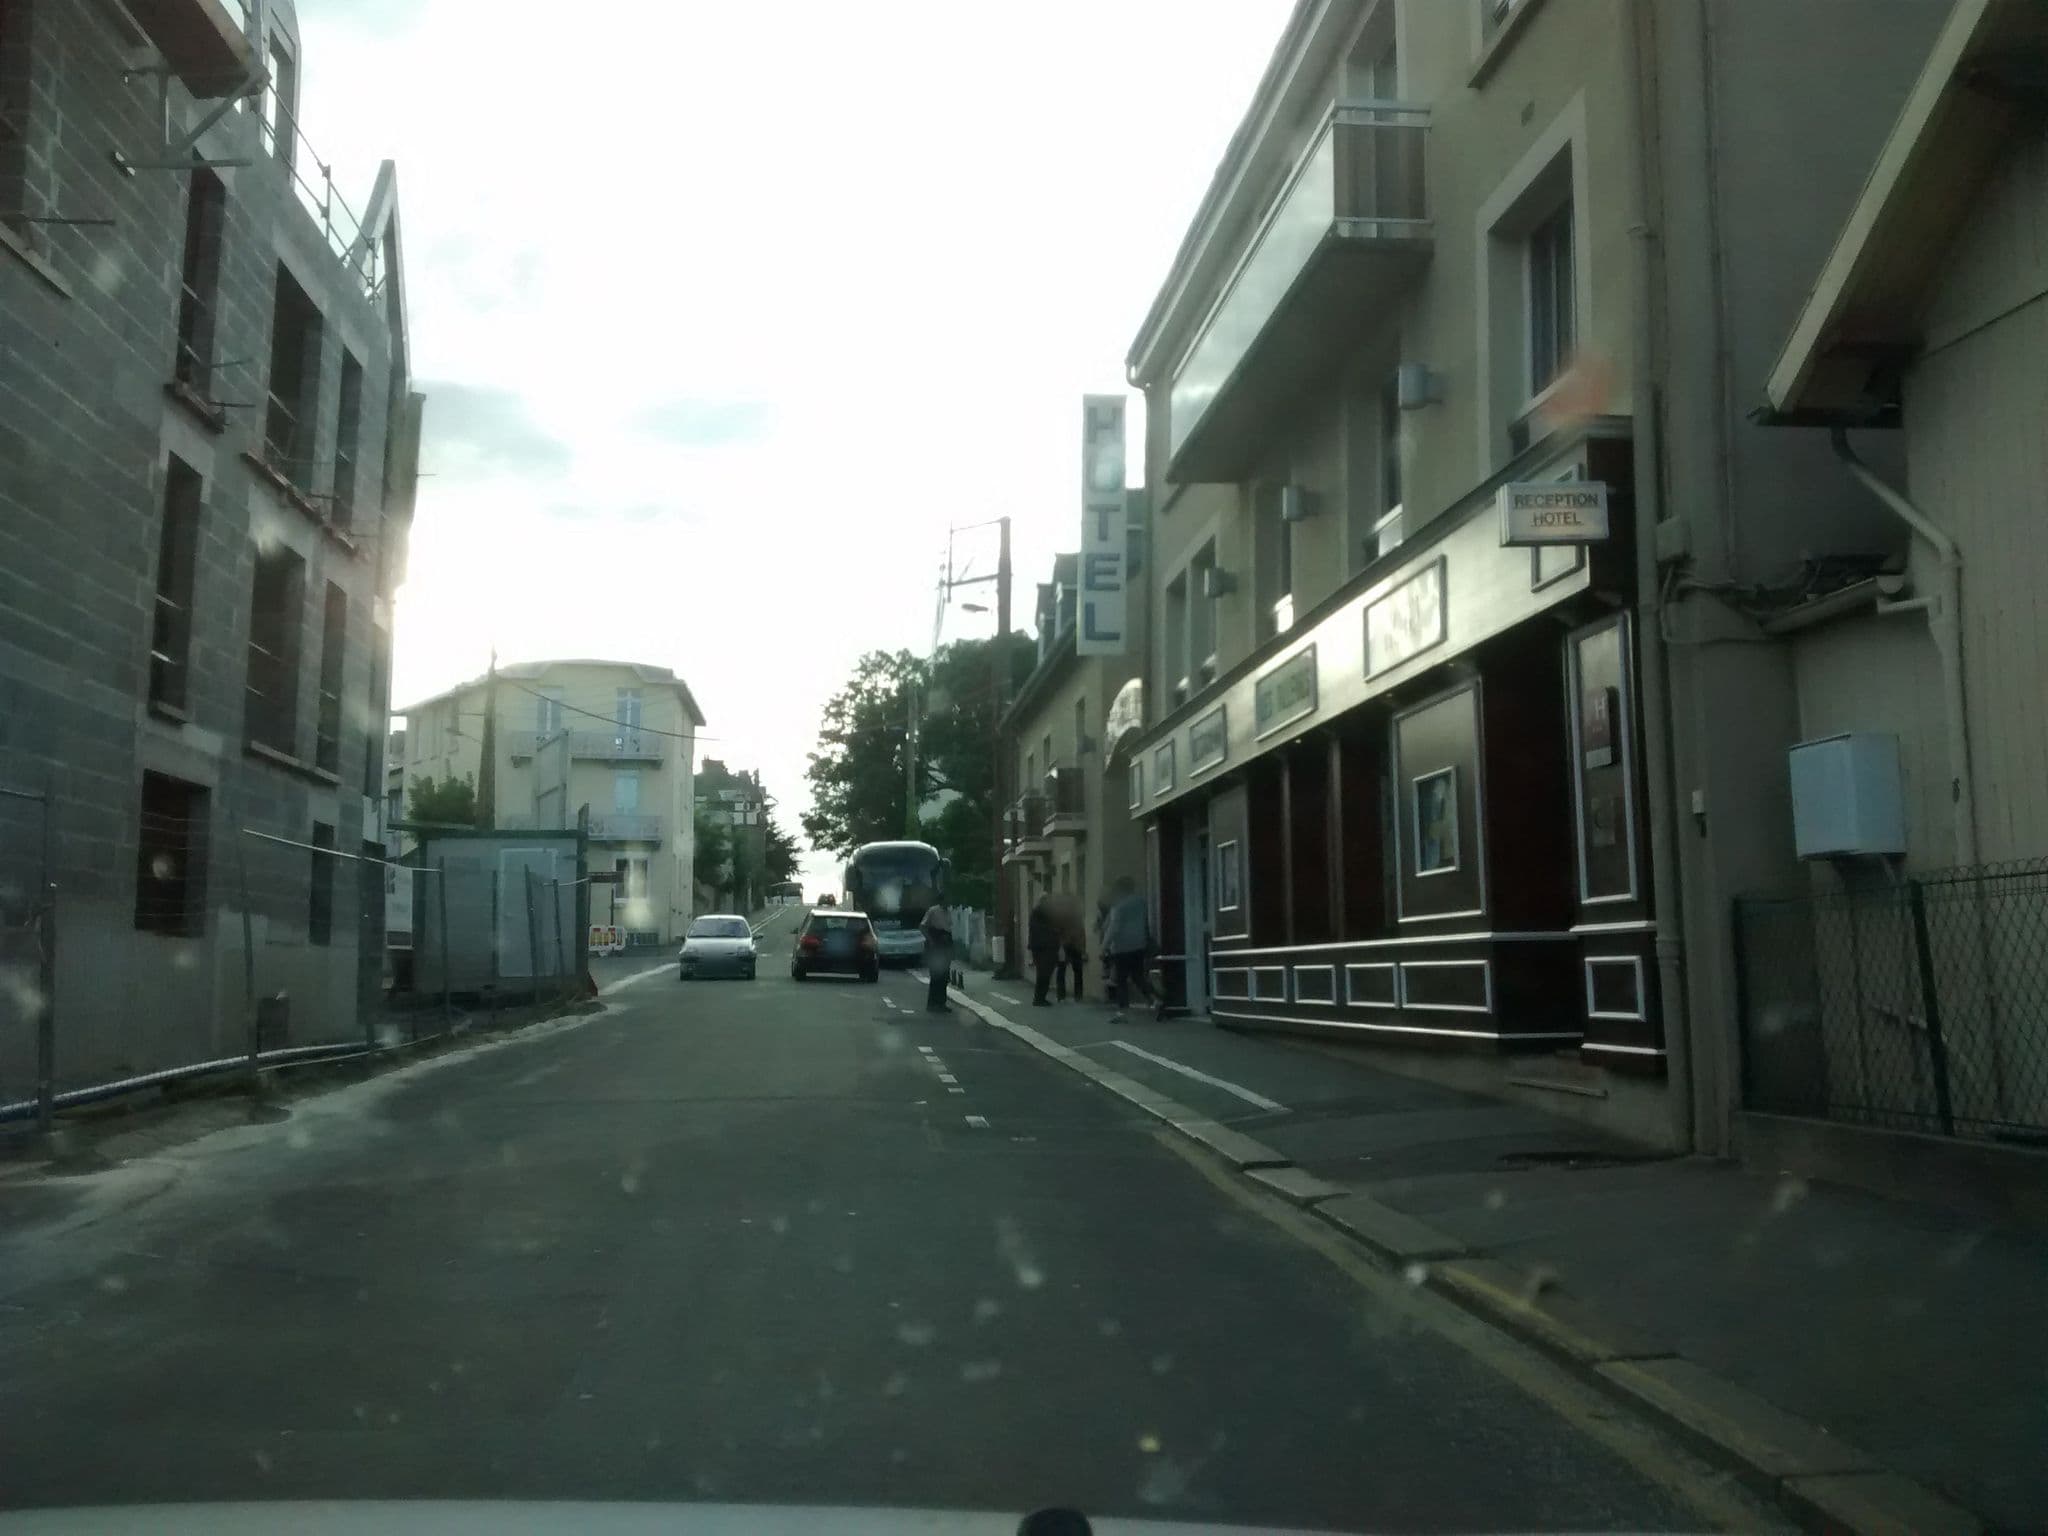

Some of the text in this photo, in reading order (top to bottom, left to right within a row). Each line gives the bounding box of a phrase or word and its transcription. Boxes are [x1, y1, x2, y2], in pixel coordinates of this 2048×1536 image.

[1514, 493, 1598, 507] RECEPTION
[1084, 406, 1120, 640] HOTEL
[1532, 511, 1580, 526] HOTEL
